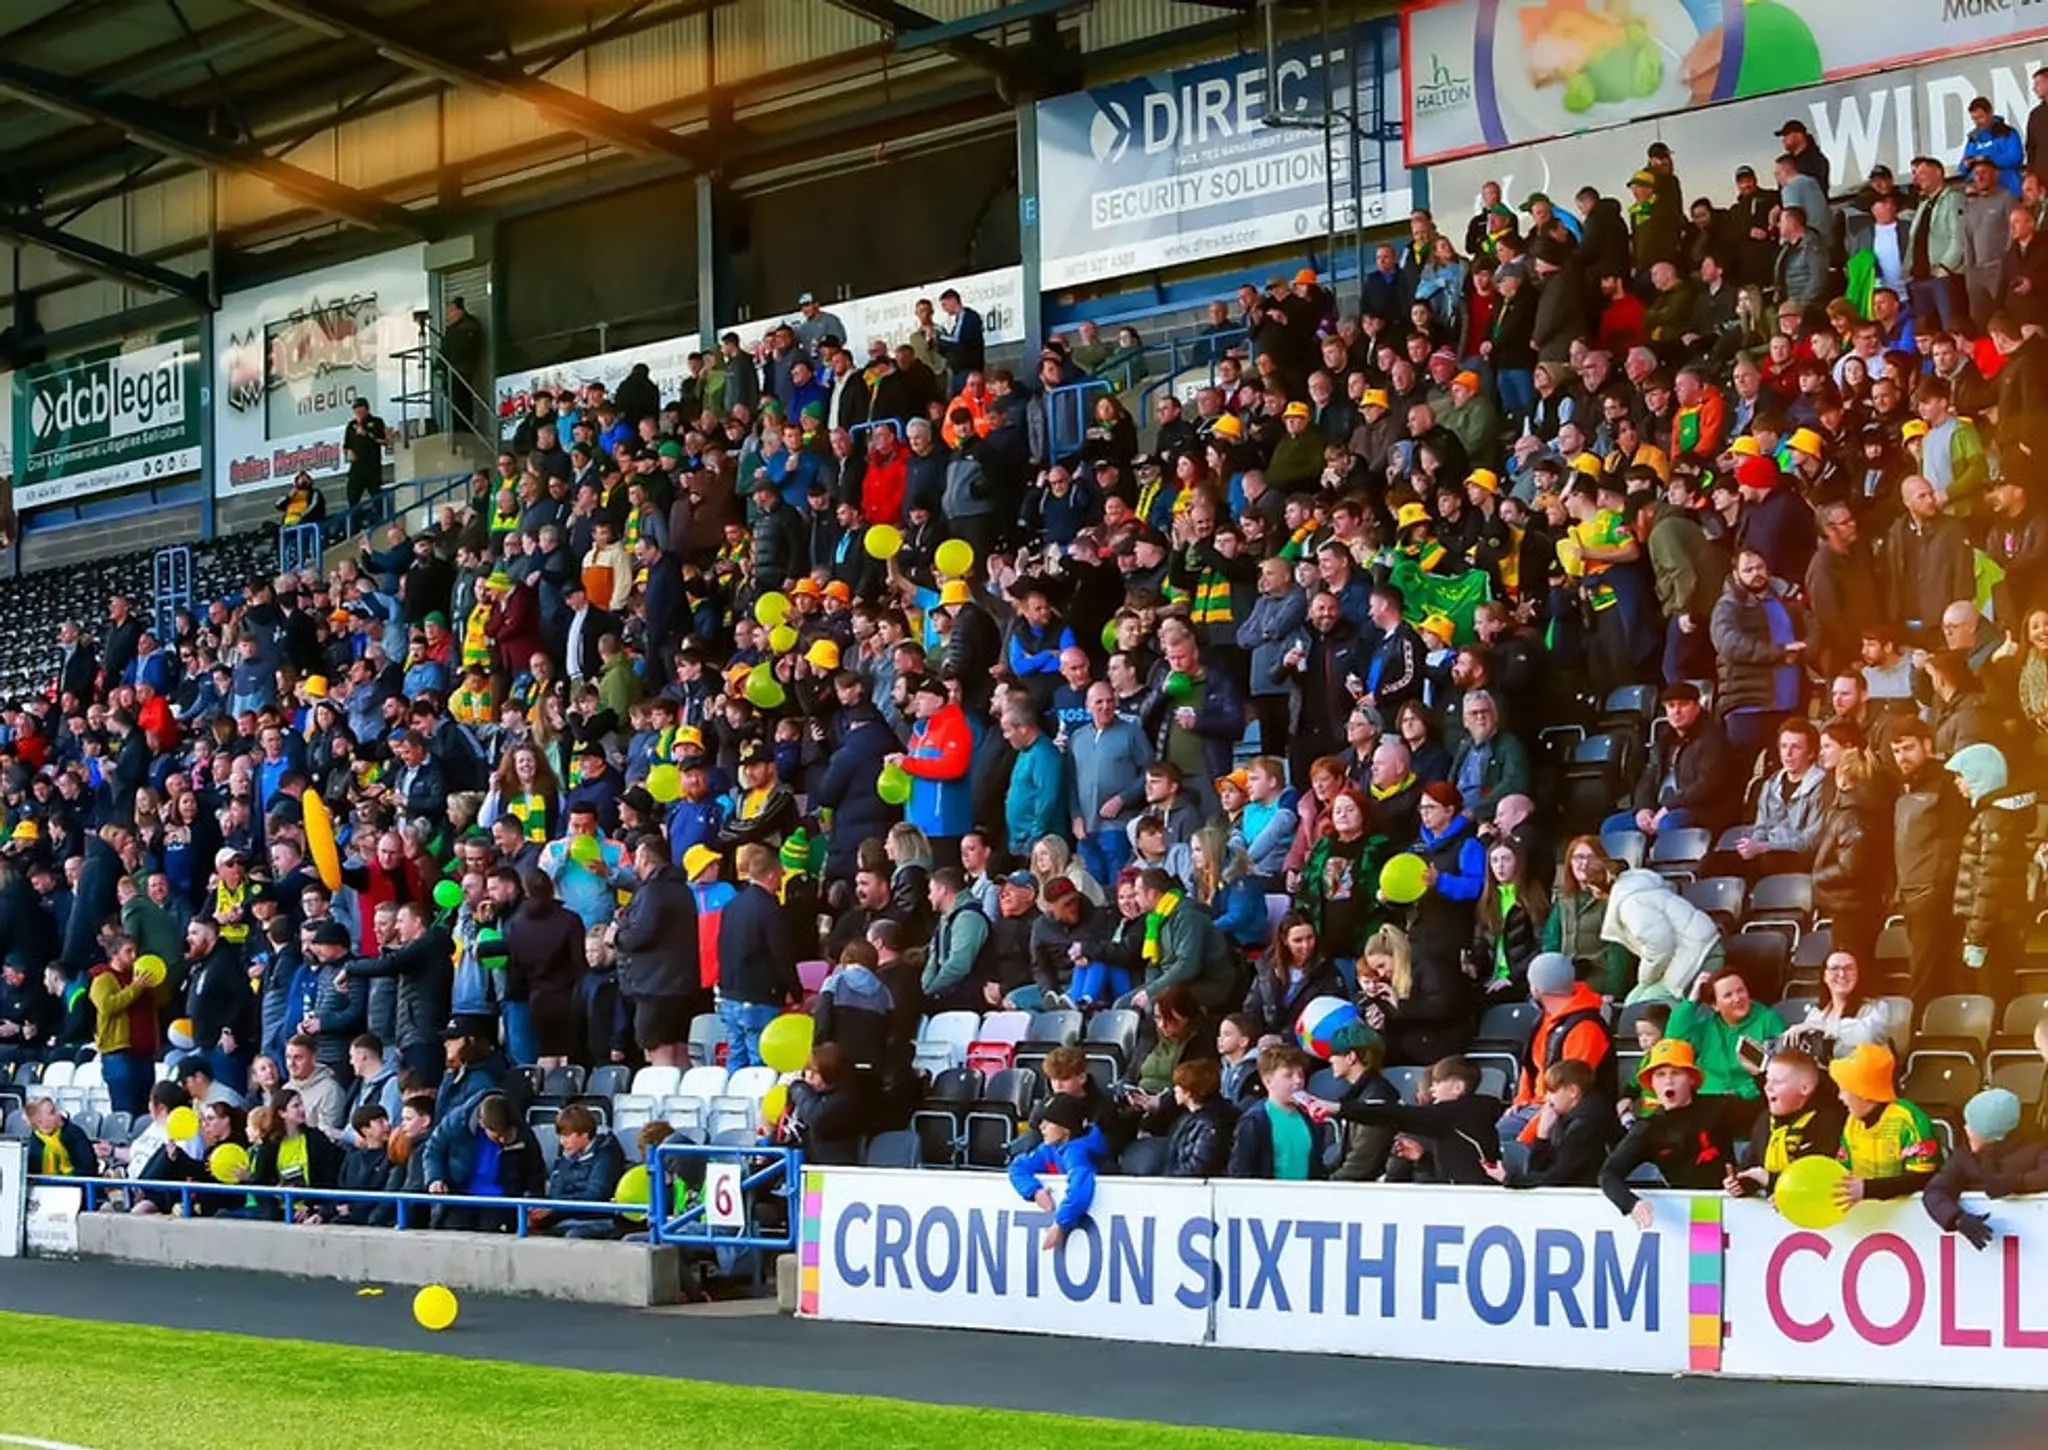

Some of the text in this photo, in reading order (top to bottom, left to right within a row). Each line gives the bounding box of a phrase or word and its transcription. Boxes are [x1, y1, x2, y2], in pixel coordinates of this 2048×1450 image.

[1143, 48, 1345, 156] DIREC
[1416, 85, 1471, 109] HALTON
[1094, 148, 1342, 223] SECURITY SOLUTIONS
[715, 1174, 733, 1216] 6
[834, 1201, 1660, 1332] CRONTON SIXTH FORM
[1765, 1231, 2048, 1349] COLL
